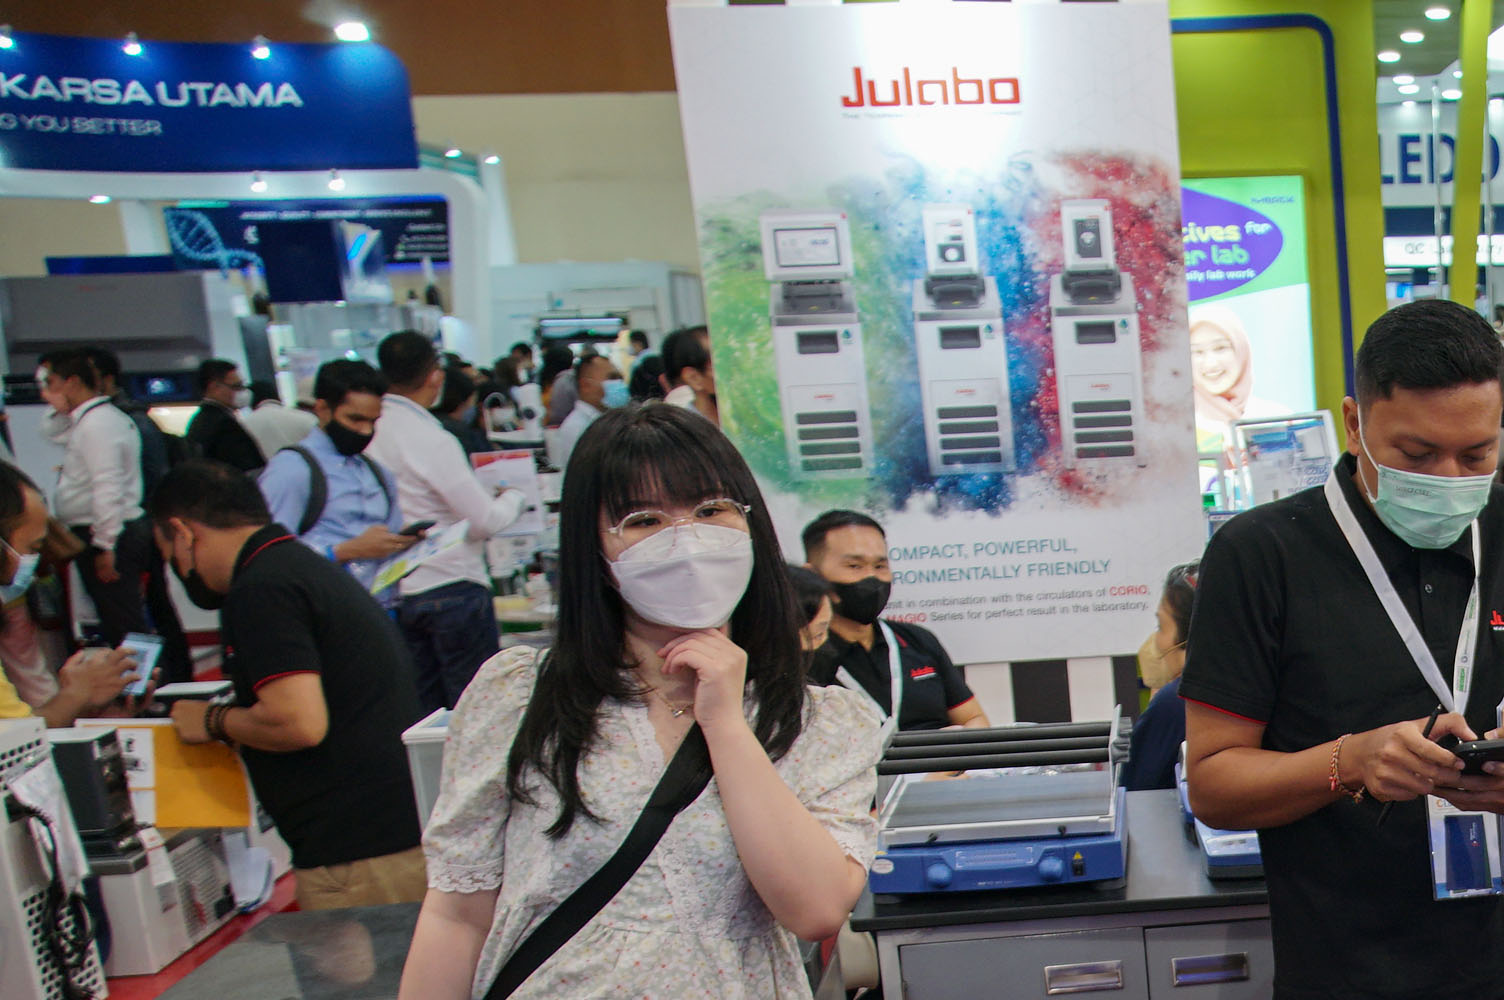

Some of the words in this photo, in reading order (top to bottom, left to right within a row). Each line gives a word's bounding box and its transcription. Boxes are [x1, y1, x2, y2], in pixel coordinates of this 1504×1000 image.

[0, 71, 154, 106] KARSA
[155, 80, 304, 107] UTAMA
[841, 66, 1021, 108] Julabo
[19, 113, 70, 134] YOU
[71, 116, 163, 136] BETTER
[1244, 221, 1273, 235] for
[1211, 244, 1251, 265] lab
[1206, 269, 1225, 280] lab
[1226, 268, 1257, 280] work
[973, 538, 1078, 557] POWERFUL,
[1027, 559, 1111, 578] FRIENDLY
[919, 594, 985, 608] combination
[991, 592, 1012, 603] with
[1016, 590, 1033, 601] the
[1036, 586, 1092, 601] circulators
[1096, 586, 1106, 598] of
[930, 610, 967, 621] Series
[967, 609, 982, 619] for
[985, 607, 1025, 620] perfect
[1027, 604, 1056, 615] result
[1060, 604, 1070, 614] in
[1072, 602, 1089, 612] the
[1092, 600, 1149, 613] laboratory.
